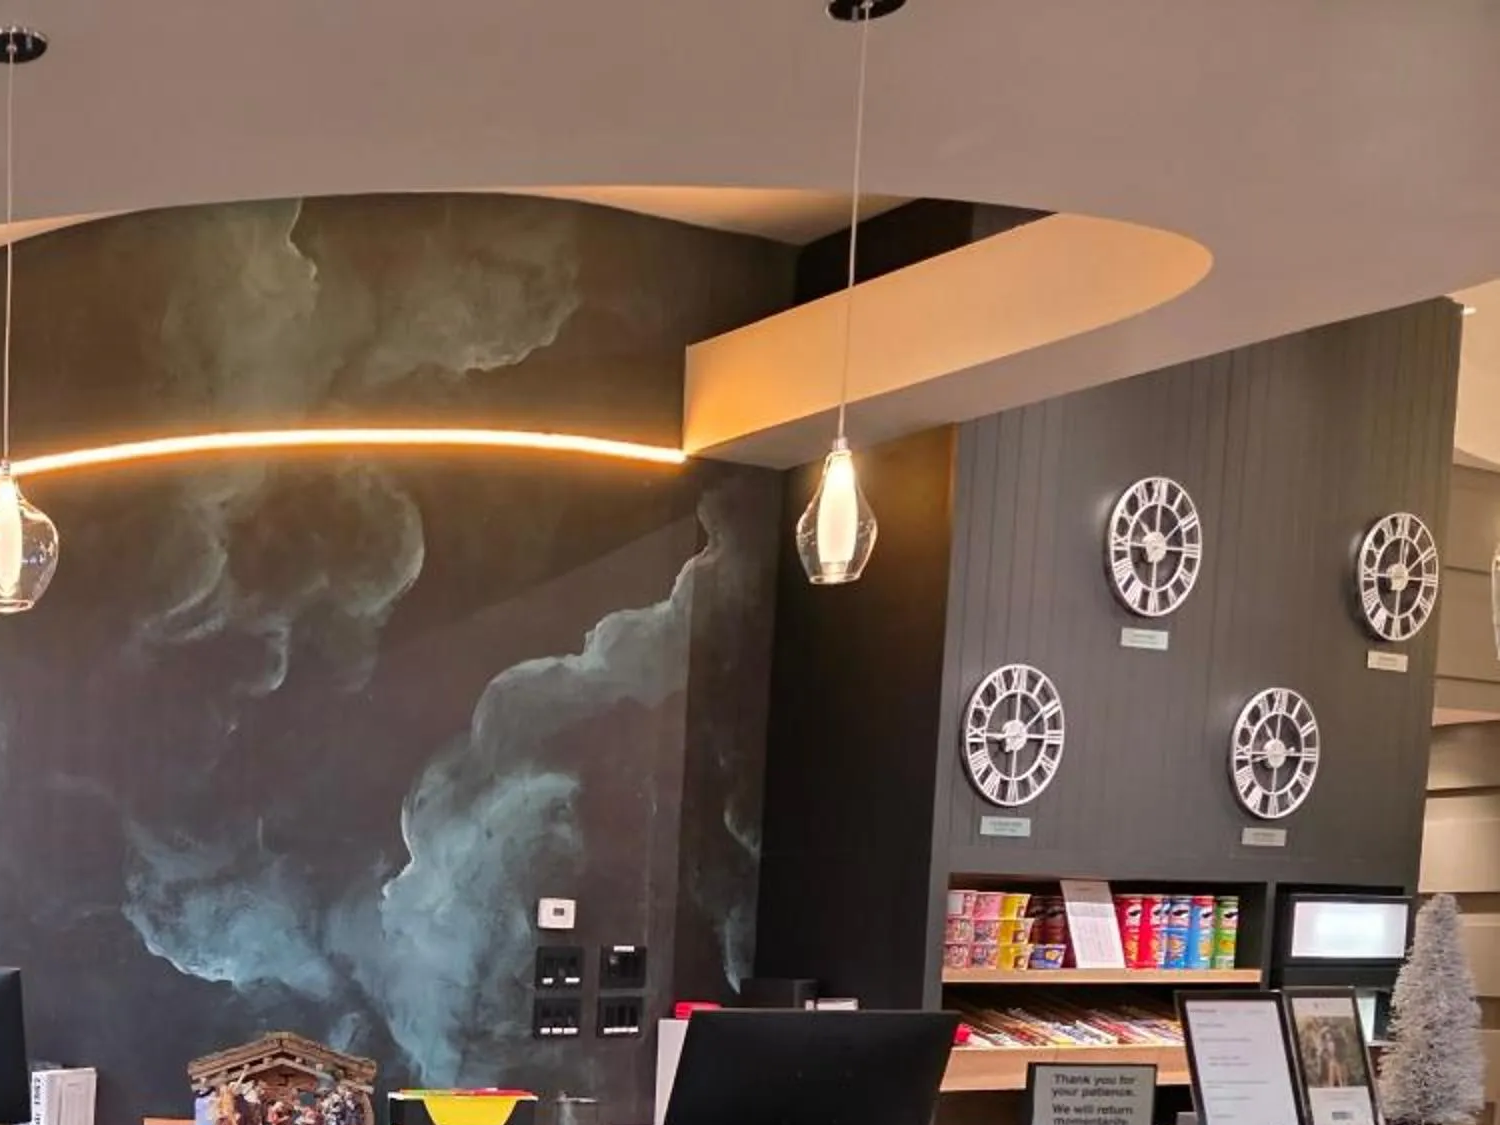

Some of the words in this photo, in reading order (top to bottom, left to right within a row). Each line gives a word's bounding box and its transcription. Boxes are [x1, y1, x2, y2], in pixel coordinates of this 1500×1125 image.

[1054, 1073, 1091, 1085] Thank
[1094, 1075, 1117, 1086] you
[1097, 1105, 1133, 1115] return
